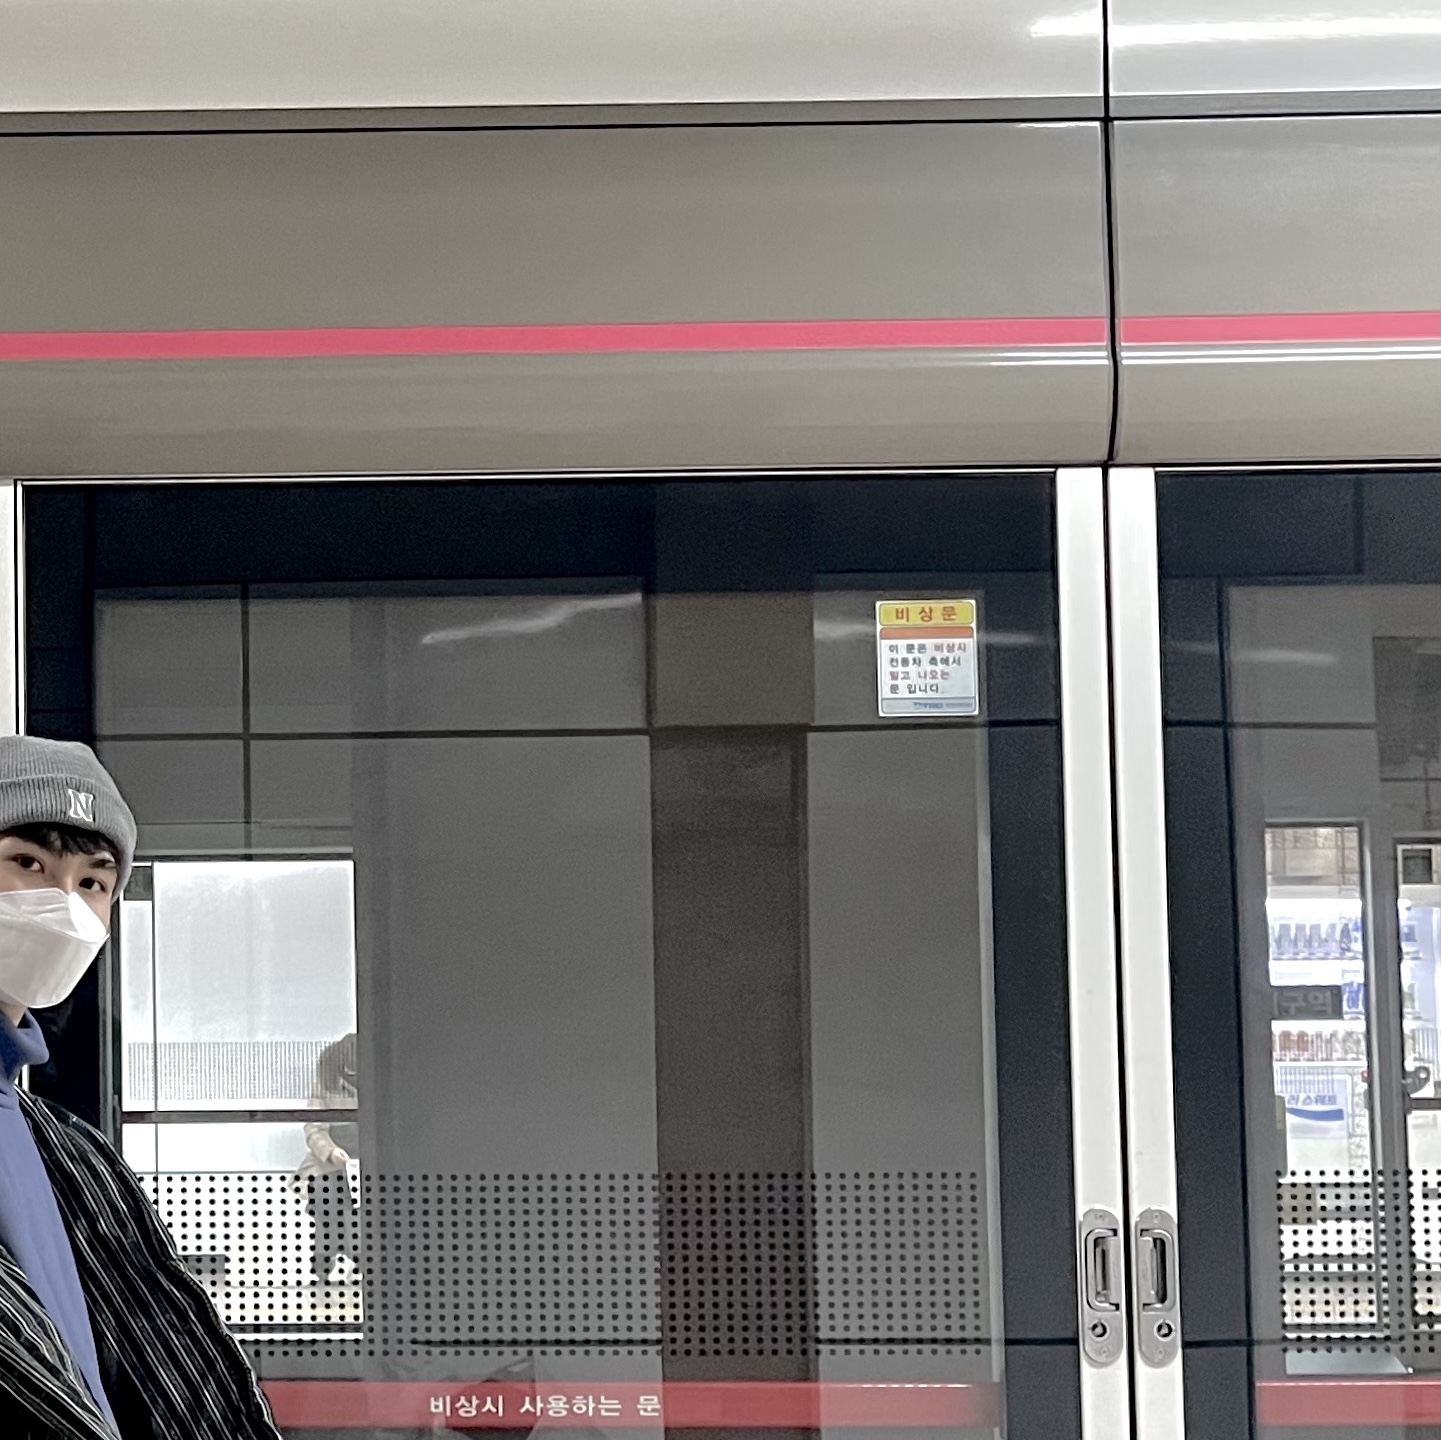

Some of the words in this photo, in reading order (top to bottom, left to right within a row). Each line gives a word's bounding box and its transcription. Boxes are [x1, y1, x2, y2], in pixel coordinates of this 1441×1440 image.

[68, 788, 94, 822] N
[430, 1396, 504, 1417] 비상시
[519, 1396, 622, 1417] 사용하는
[637, 1396, 661, 1416] 문
